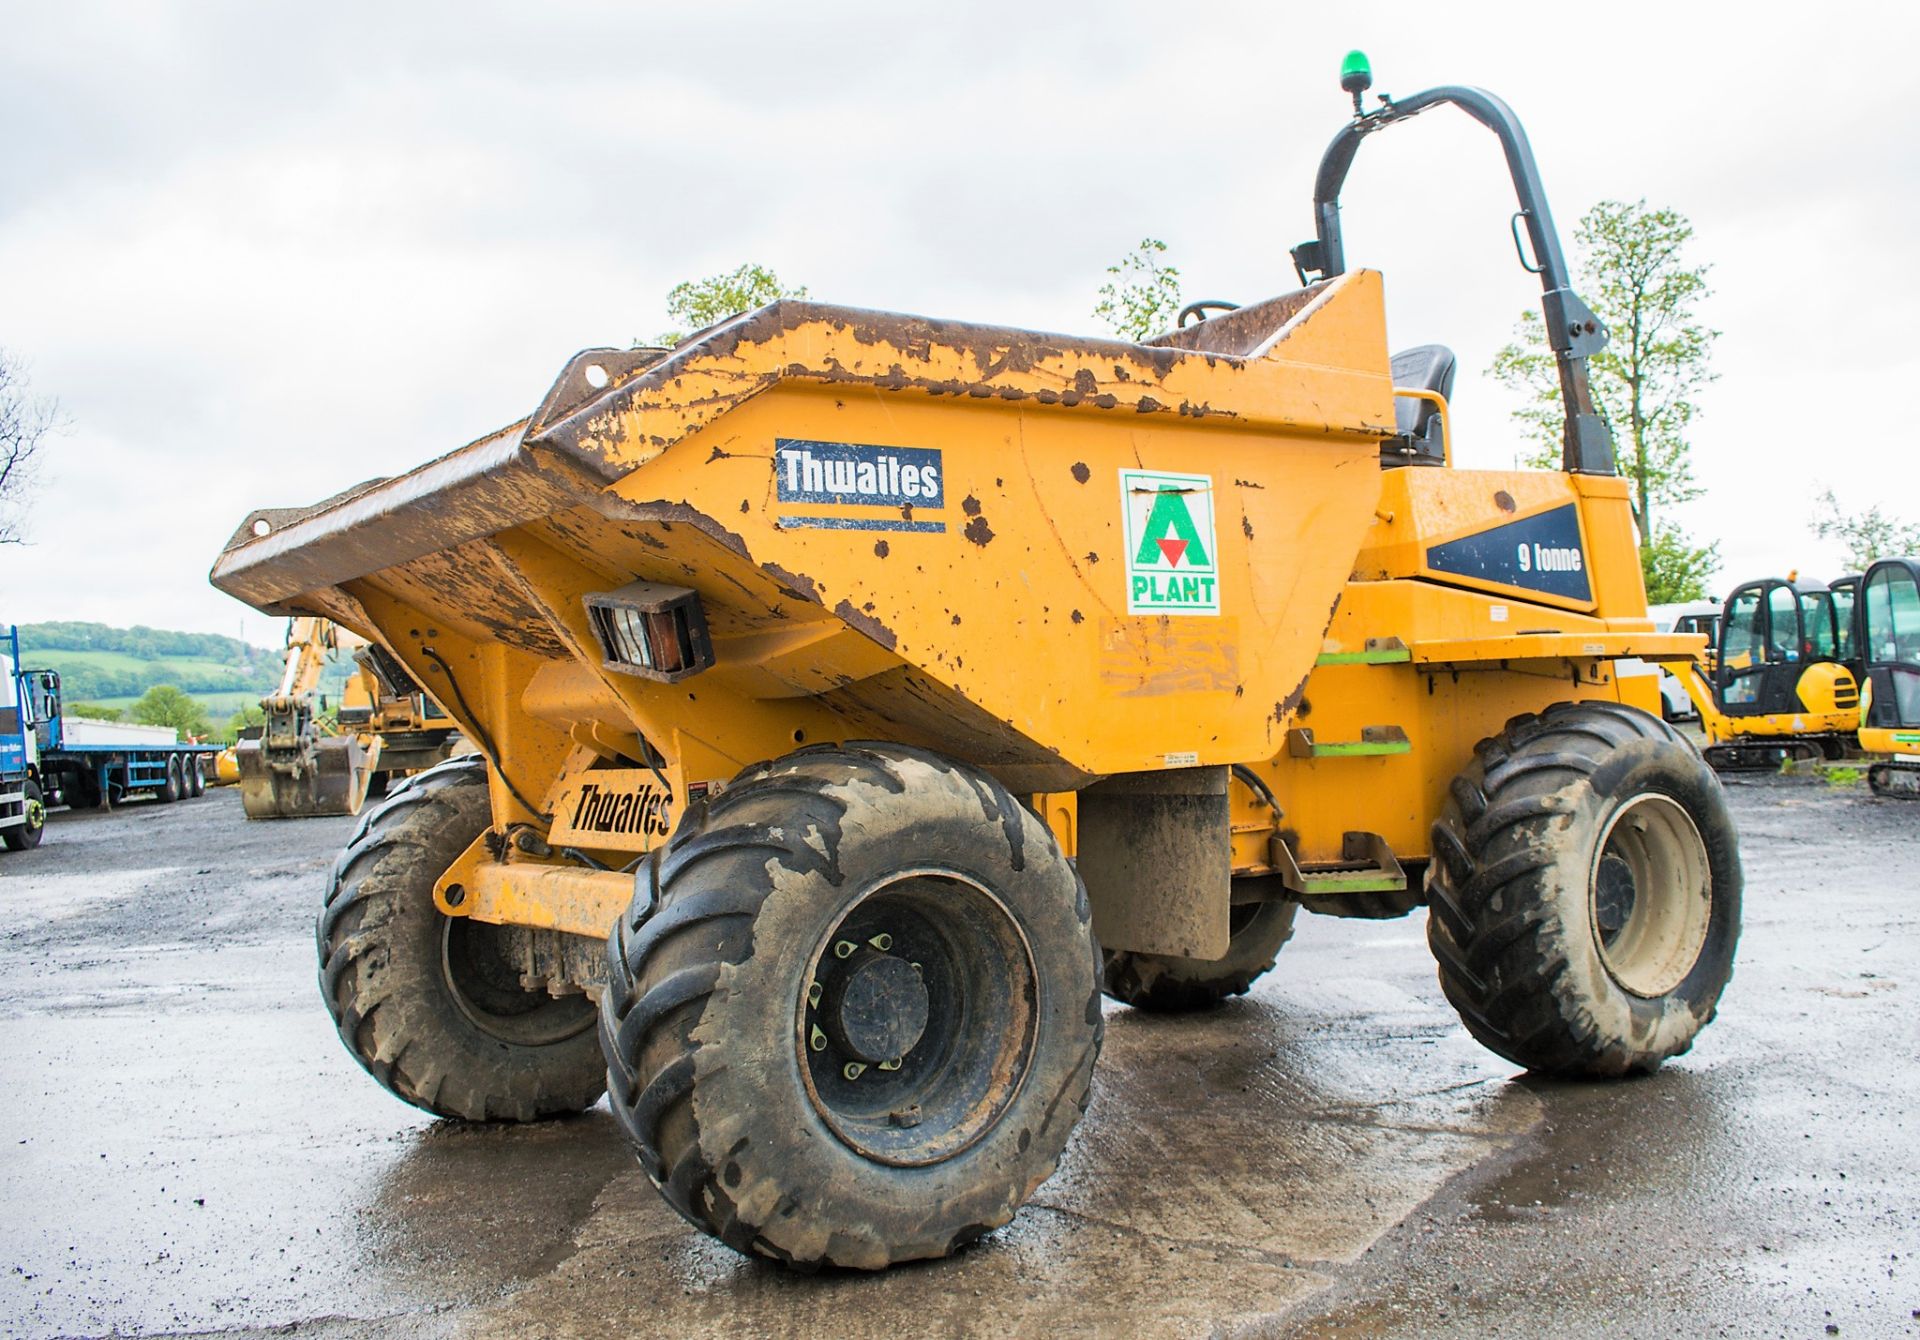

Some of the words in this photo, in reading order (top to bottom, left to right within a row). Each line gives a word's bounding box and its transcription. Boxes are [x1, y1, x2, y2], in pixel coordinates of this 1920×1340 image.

[781, 449, 939, 498] Thwaites
[1135, 484, 1211, 567] A
[1517, 542, 1531, 572] 9
[1534, 543, 1582, 572] tonne
[1132, 575, 1216, 604] PLANT
[571, 784, 674, 837] Thwaites
